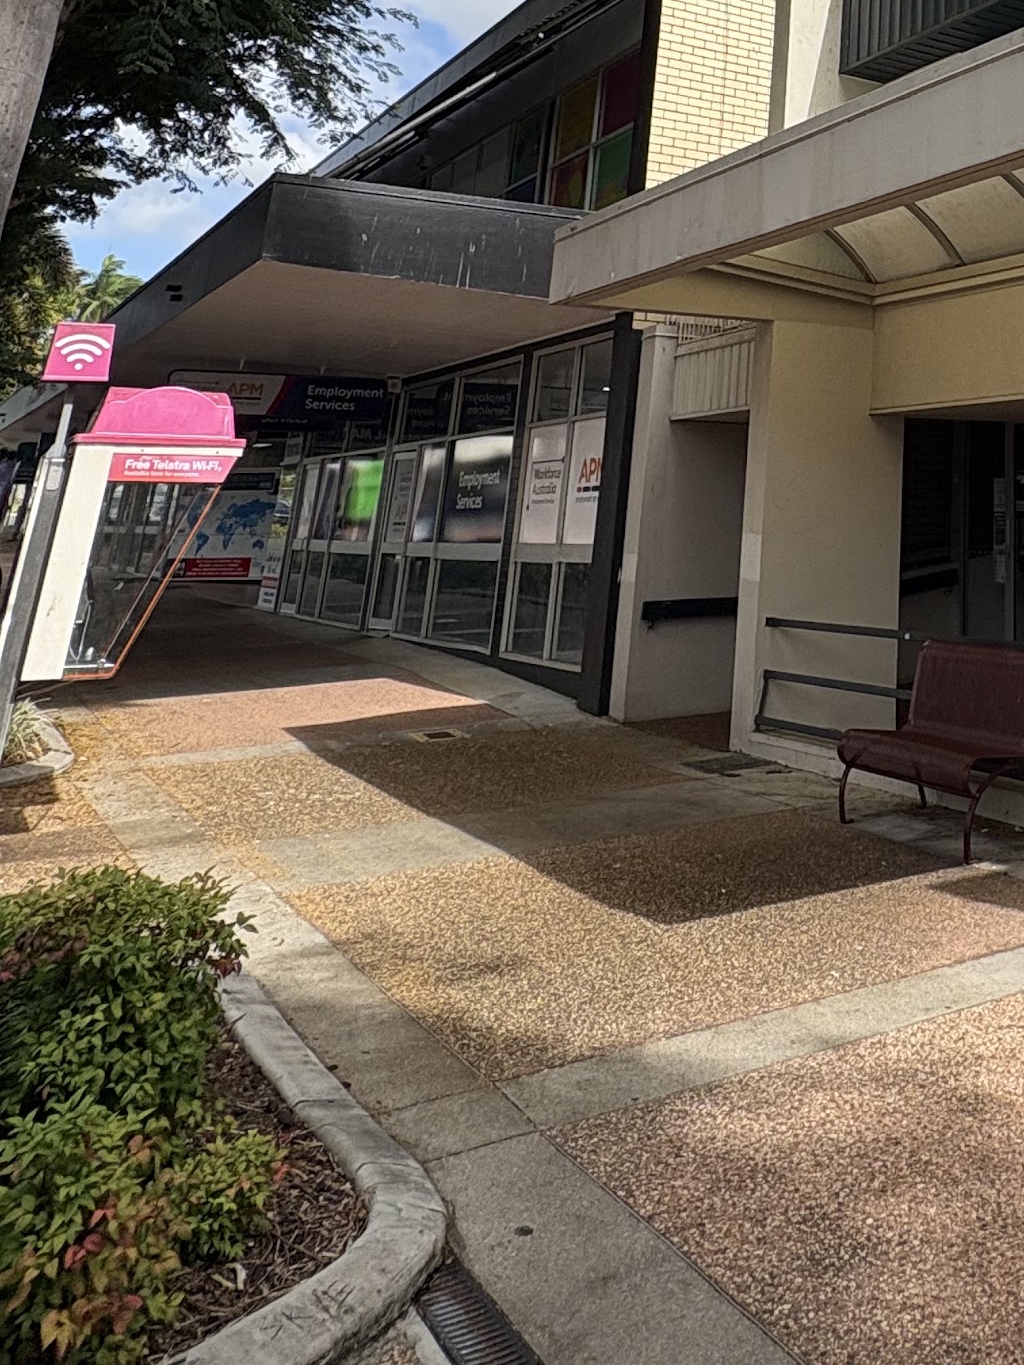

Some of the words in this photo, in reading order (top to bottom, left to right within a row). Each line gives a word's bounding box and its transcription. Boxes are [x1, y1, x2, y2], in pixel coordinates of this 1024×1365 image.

[228, 383, 263, 395] APM
[307, 385, 384, 398] Employment
[305, 398, 355, 411] Services
[124, 458, 149, 469] Free
[153, 459, 190, 470] Telstra
[458, 469, 501, 490] Employment
[455, 493, 483, 510] Services
